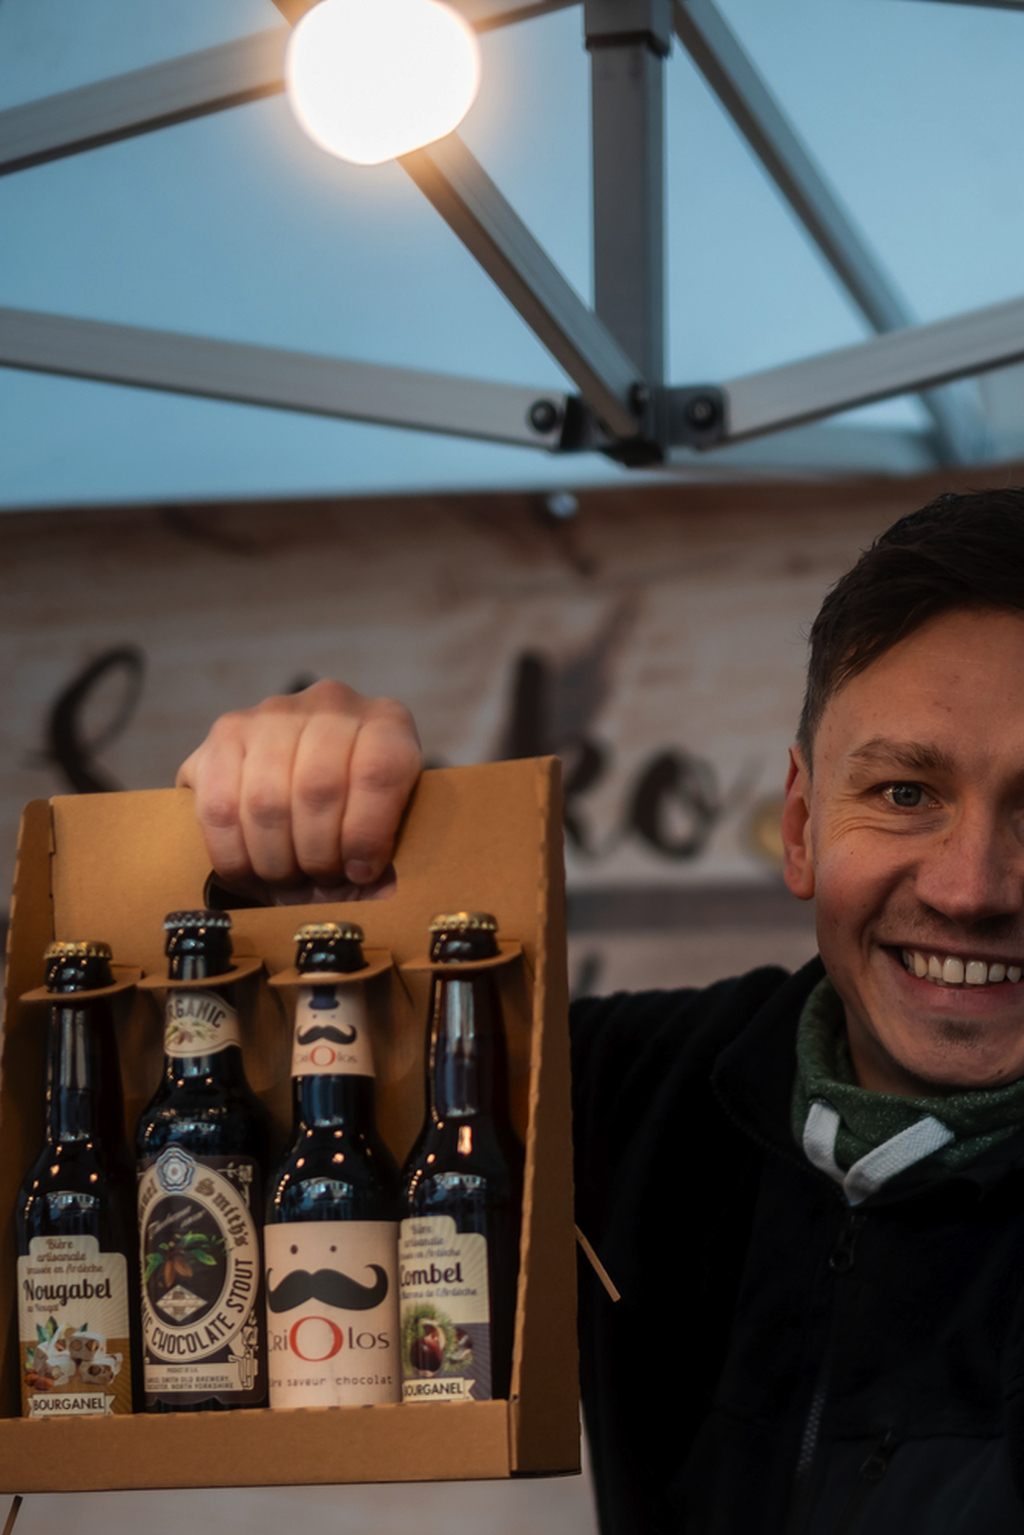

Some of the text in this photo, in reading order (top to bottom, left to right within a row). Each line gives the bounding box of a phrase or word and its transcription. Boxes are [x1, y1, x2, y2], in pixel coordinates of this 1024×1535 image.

[166, 998, 226, 1028] RGANIC
[46, 1239, 74, 1250] Bière
[36, 1252, 87, 1262] artisanale
[23, 1278, 112, 1306] Nougabel
[151, 1311, 236, 1355] CHOCOLATE
[226, 1258, 253, 1314] STOUT
[335, 1375, 393, 1386] chocolat
[34, 1398, 105, 1411] BOURGANEL
